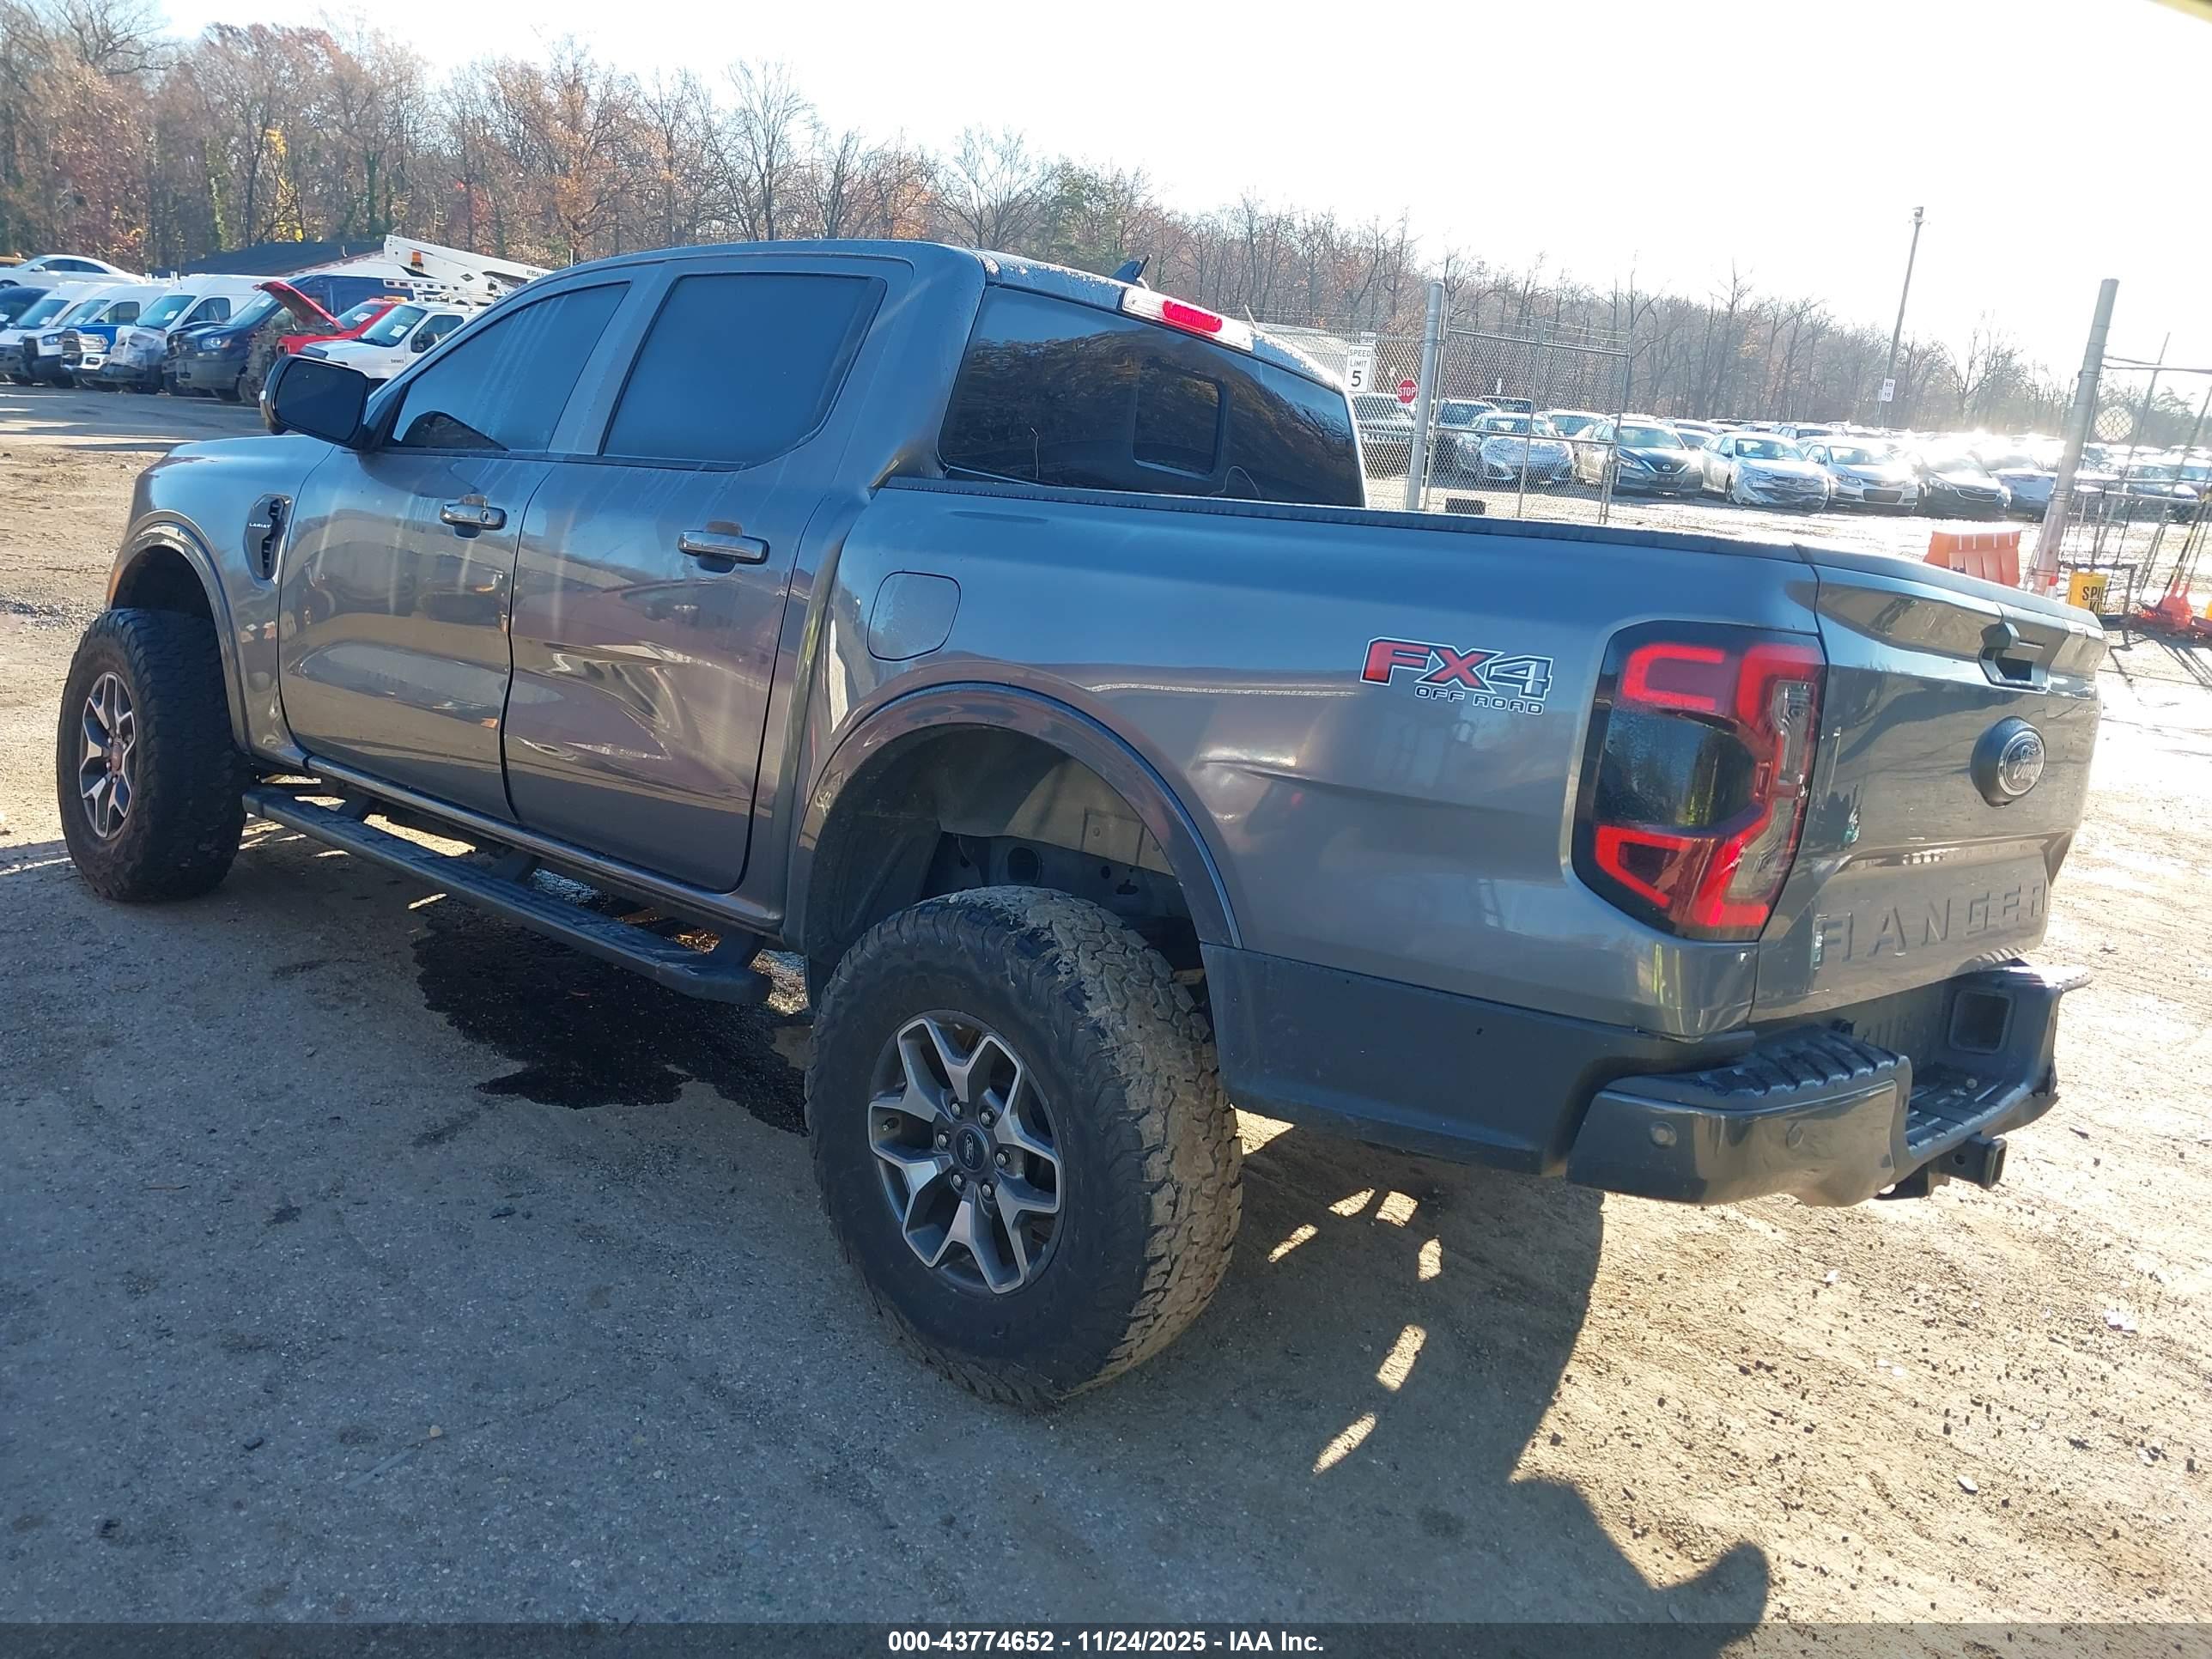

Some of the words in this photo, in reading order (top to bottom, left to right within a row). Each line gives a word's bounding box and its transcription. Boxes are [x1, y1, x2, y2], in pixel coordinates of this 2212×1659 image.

[1350, 358, 1368, 368] LIMIT
[1351, 370, 1362, 387] 5
[1398, 386, 1416, 397] STOP
[1360, 636, 1553, 701] FX4
[1415, 685, 1465, 702] OFF
[1473, 694, 1544, 715] ROAD
[1812, 878, 2047, 969] RANGER
